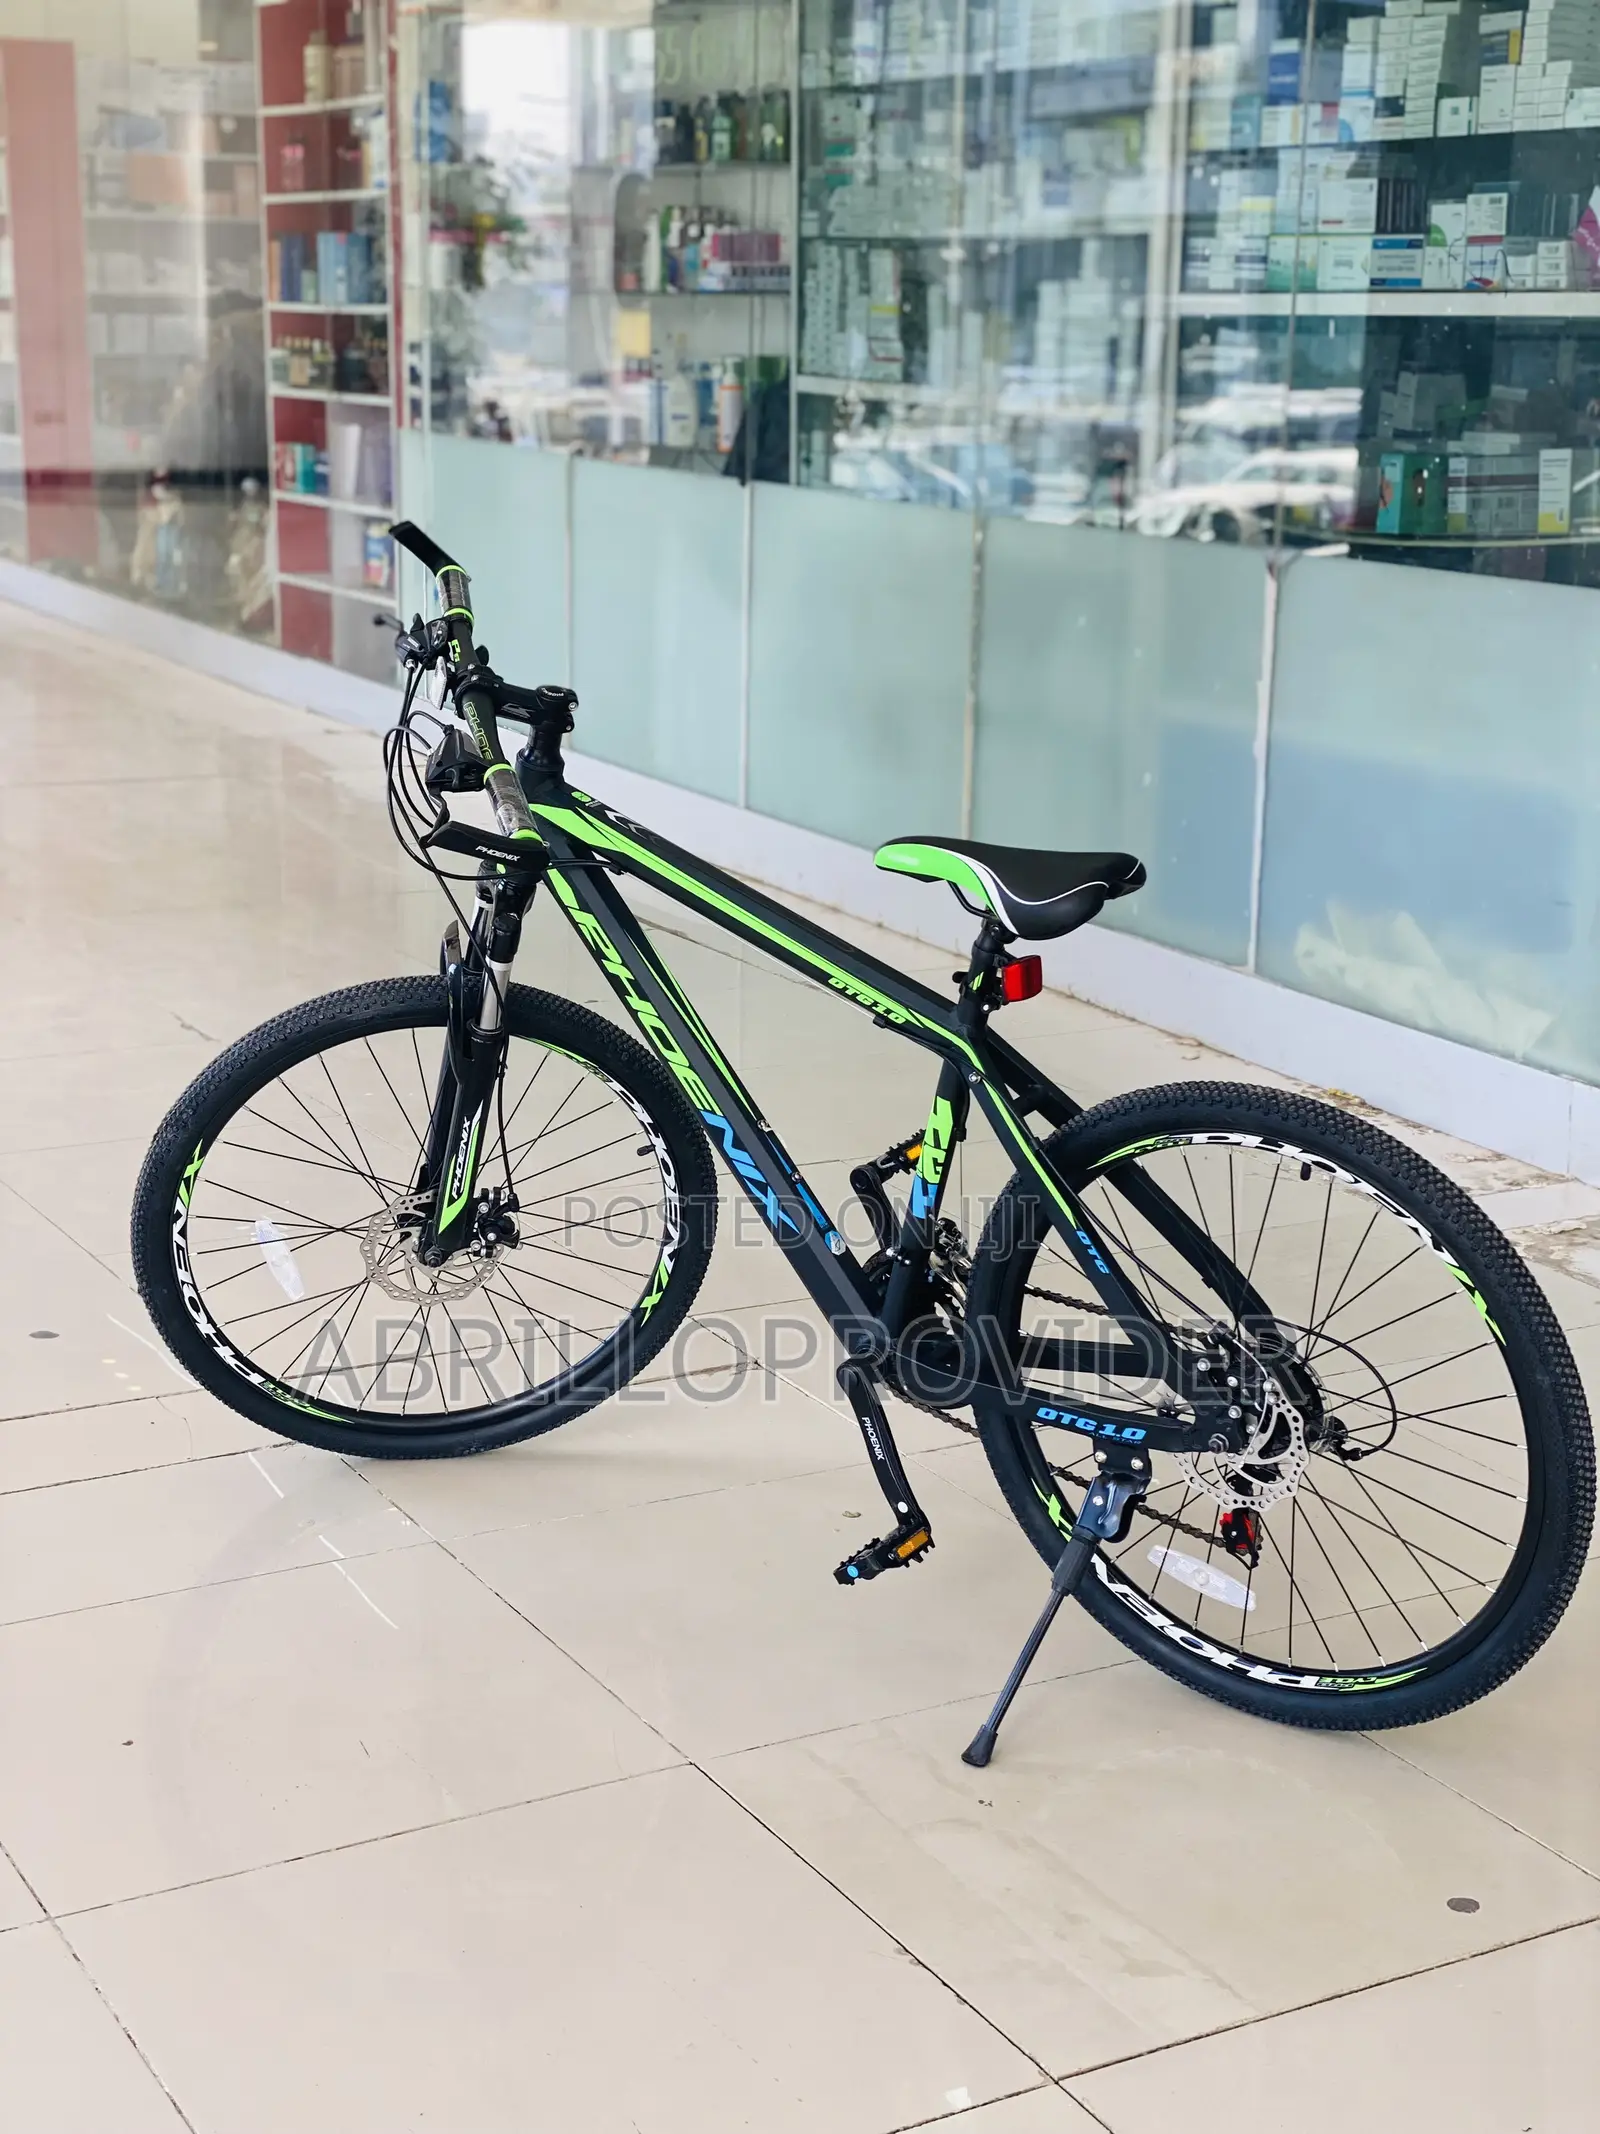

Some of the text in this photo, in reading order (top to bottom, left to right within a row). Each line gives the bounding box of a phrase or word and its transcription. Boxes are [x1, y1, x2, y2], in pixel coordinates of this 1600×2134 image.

[463, 701, 494, 760] PHOE
[475, 845, 521, 861] PHOENIX
[574, 908, 800, 1234] PHOENIX
[451, 1115, 471, 1200] PHOENIX
[861, 1416, 885, 1461] PHOENIX
